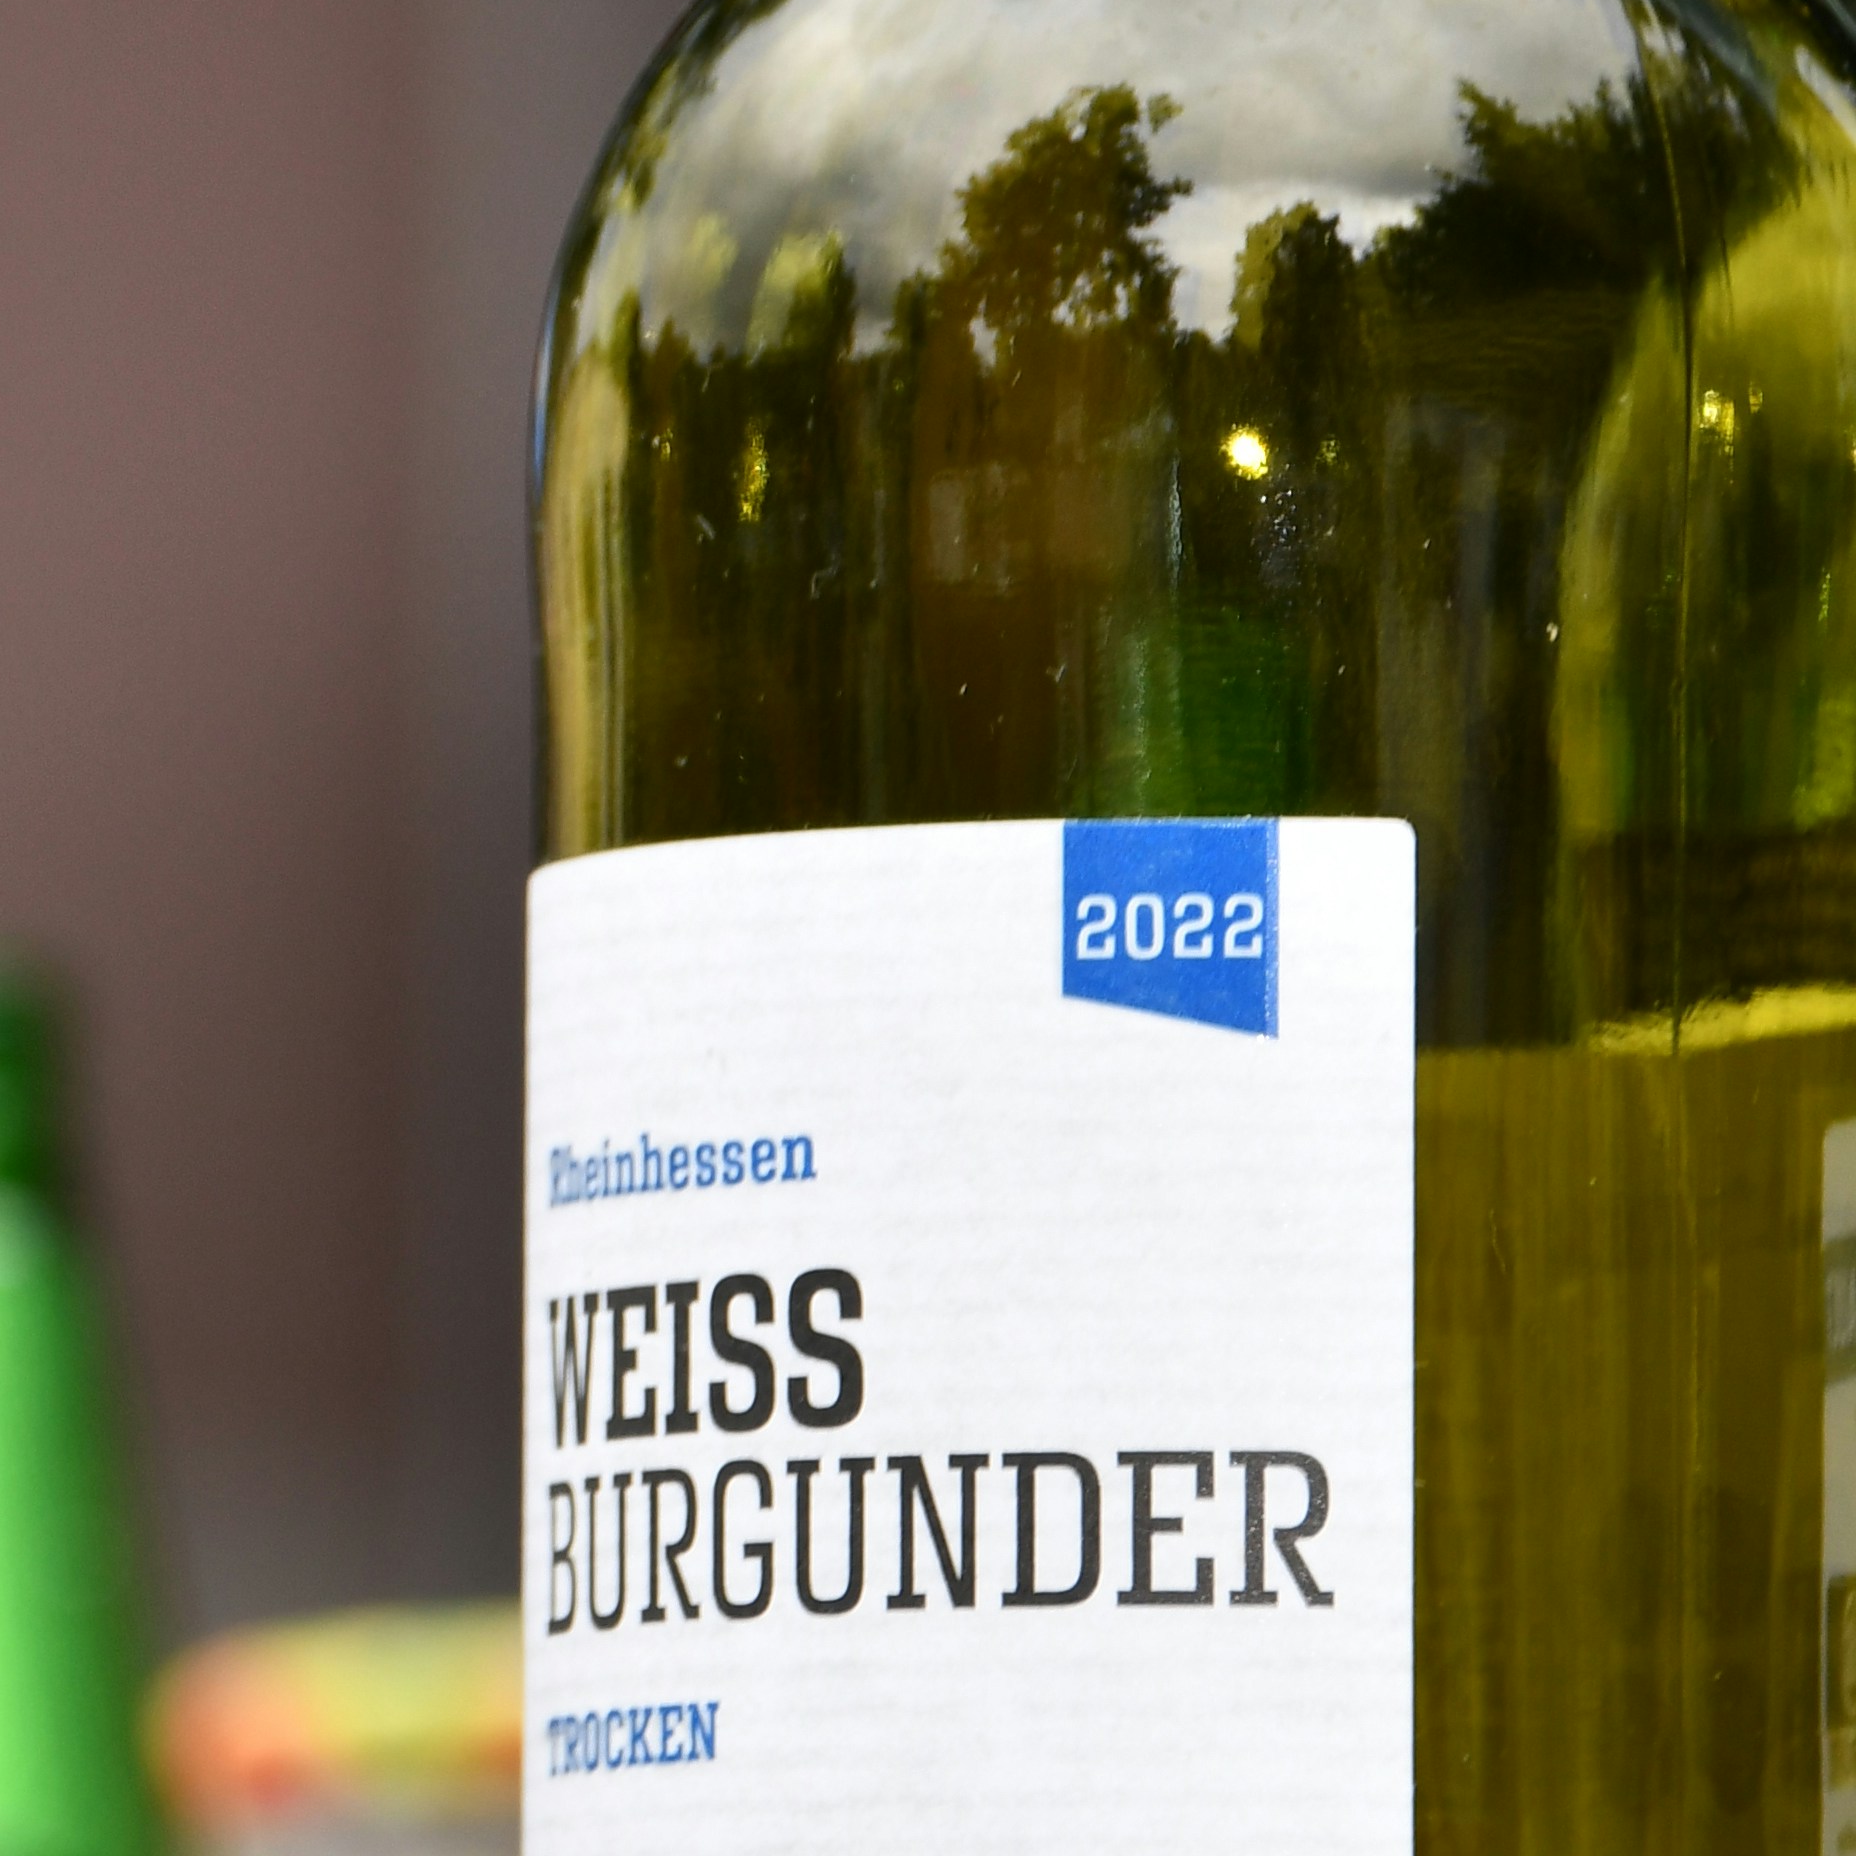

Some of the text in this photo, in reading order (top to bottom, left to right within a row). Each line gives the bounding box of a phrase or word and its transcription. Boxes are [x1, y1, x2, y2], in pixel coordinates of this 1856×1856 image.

[1077, 894, 1263, 959] 2022
[550, 1133, 817, 1207] Rheinhessen
[549, 1267, 864, 1449] WEISS
[547, 1449, 1334, 1636] BURGUNDER
[547, 1701, 719, 1776] TROCKEN
